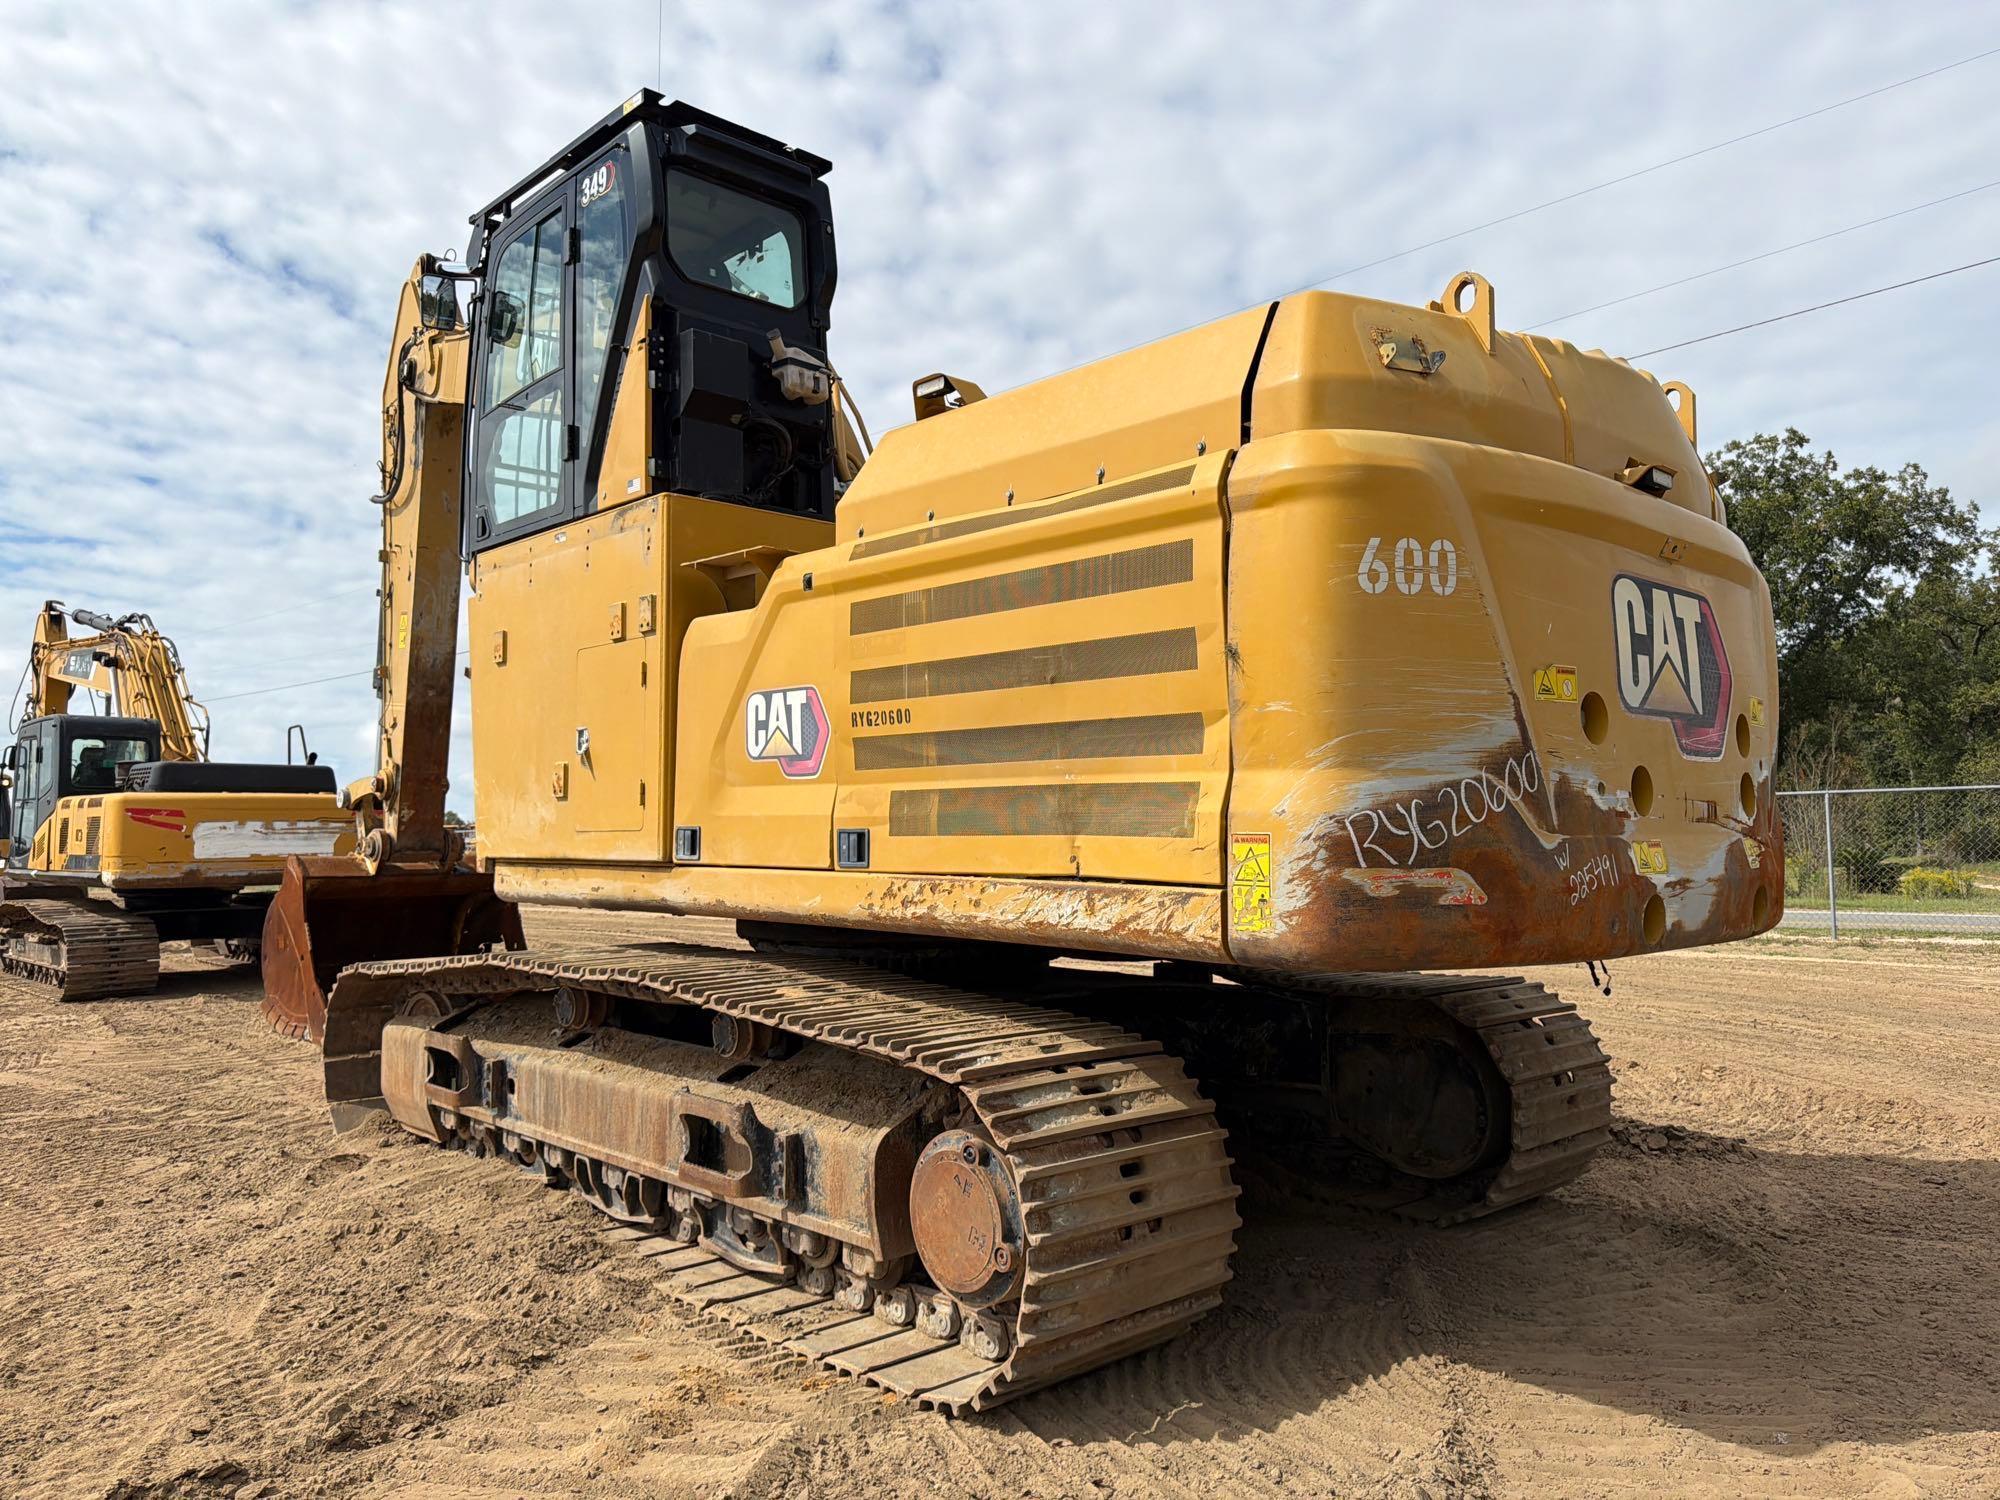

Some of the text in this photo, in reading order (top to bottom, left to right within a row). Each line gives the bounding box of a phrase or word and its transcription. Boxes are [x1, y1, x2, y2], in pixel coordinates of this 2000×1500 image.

[581, 166, 607, 204] 349
[1357, 537, 1457, 597] 600
[1613, 576, 1703, 716] CAT
[747, 689, 807, 758] CAT
[851, 708, 911, 728] RYG20600
[1345, 750, 1539, 868] RYG20600
[1569, 853, 1619, 906] 225491
